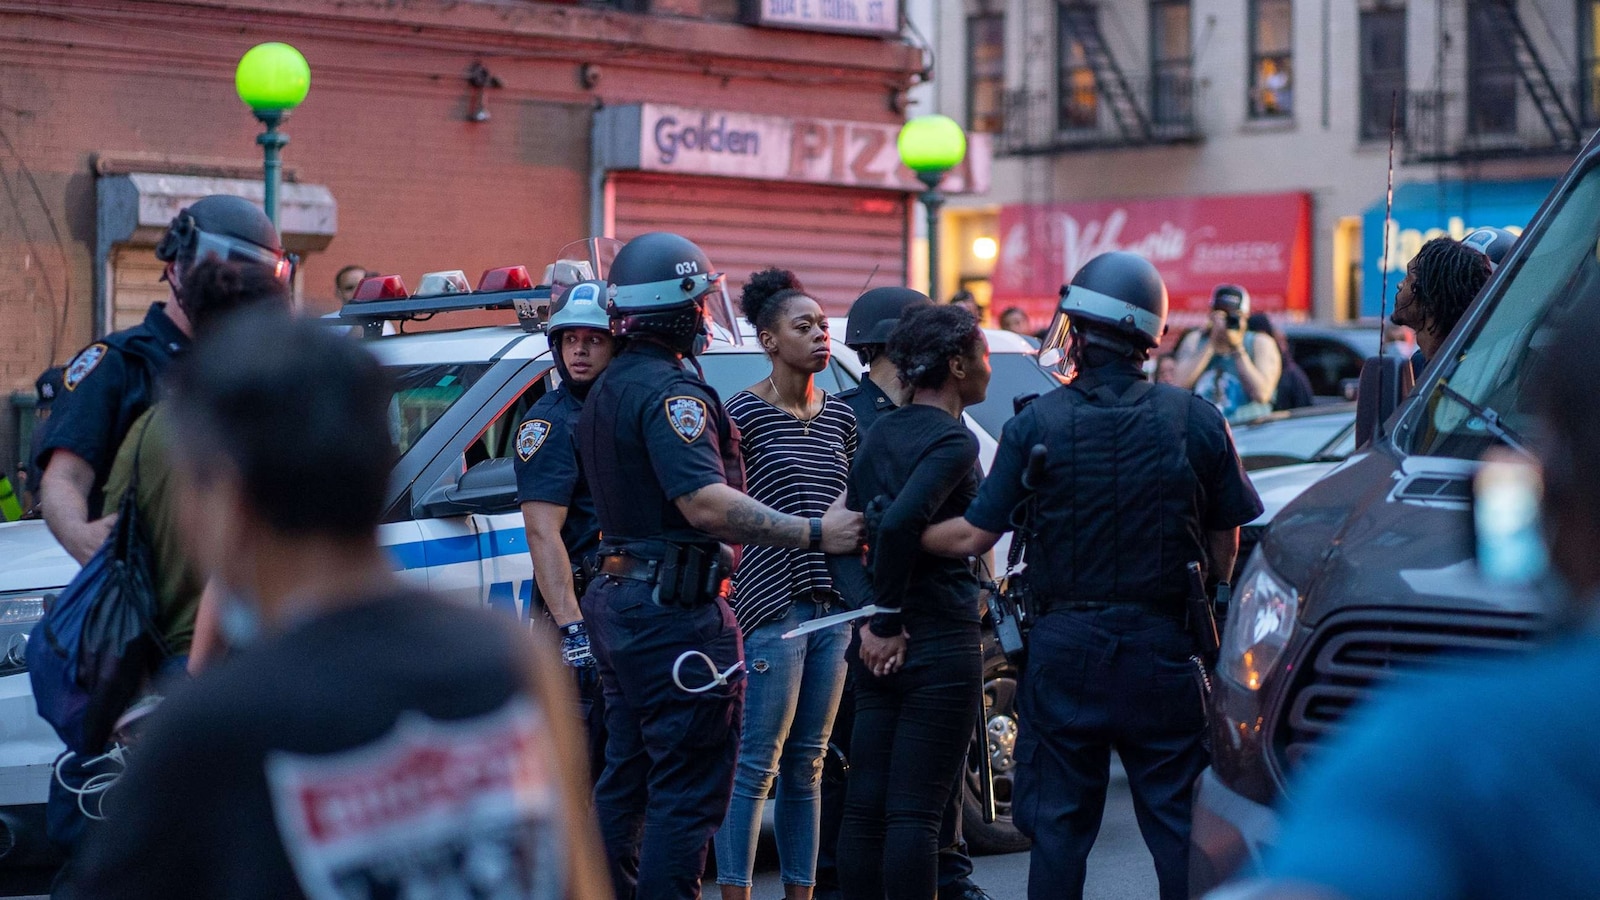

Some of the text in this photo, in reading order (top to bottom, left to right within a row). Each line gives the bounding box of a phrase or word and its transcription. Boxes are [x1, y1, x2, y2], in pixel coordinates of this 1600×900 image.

[654, 116, 974, 190] Golden PIZ
[675, 261, 698, 276] 031
